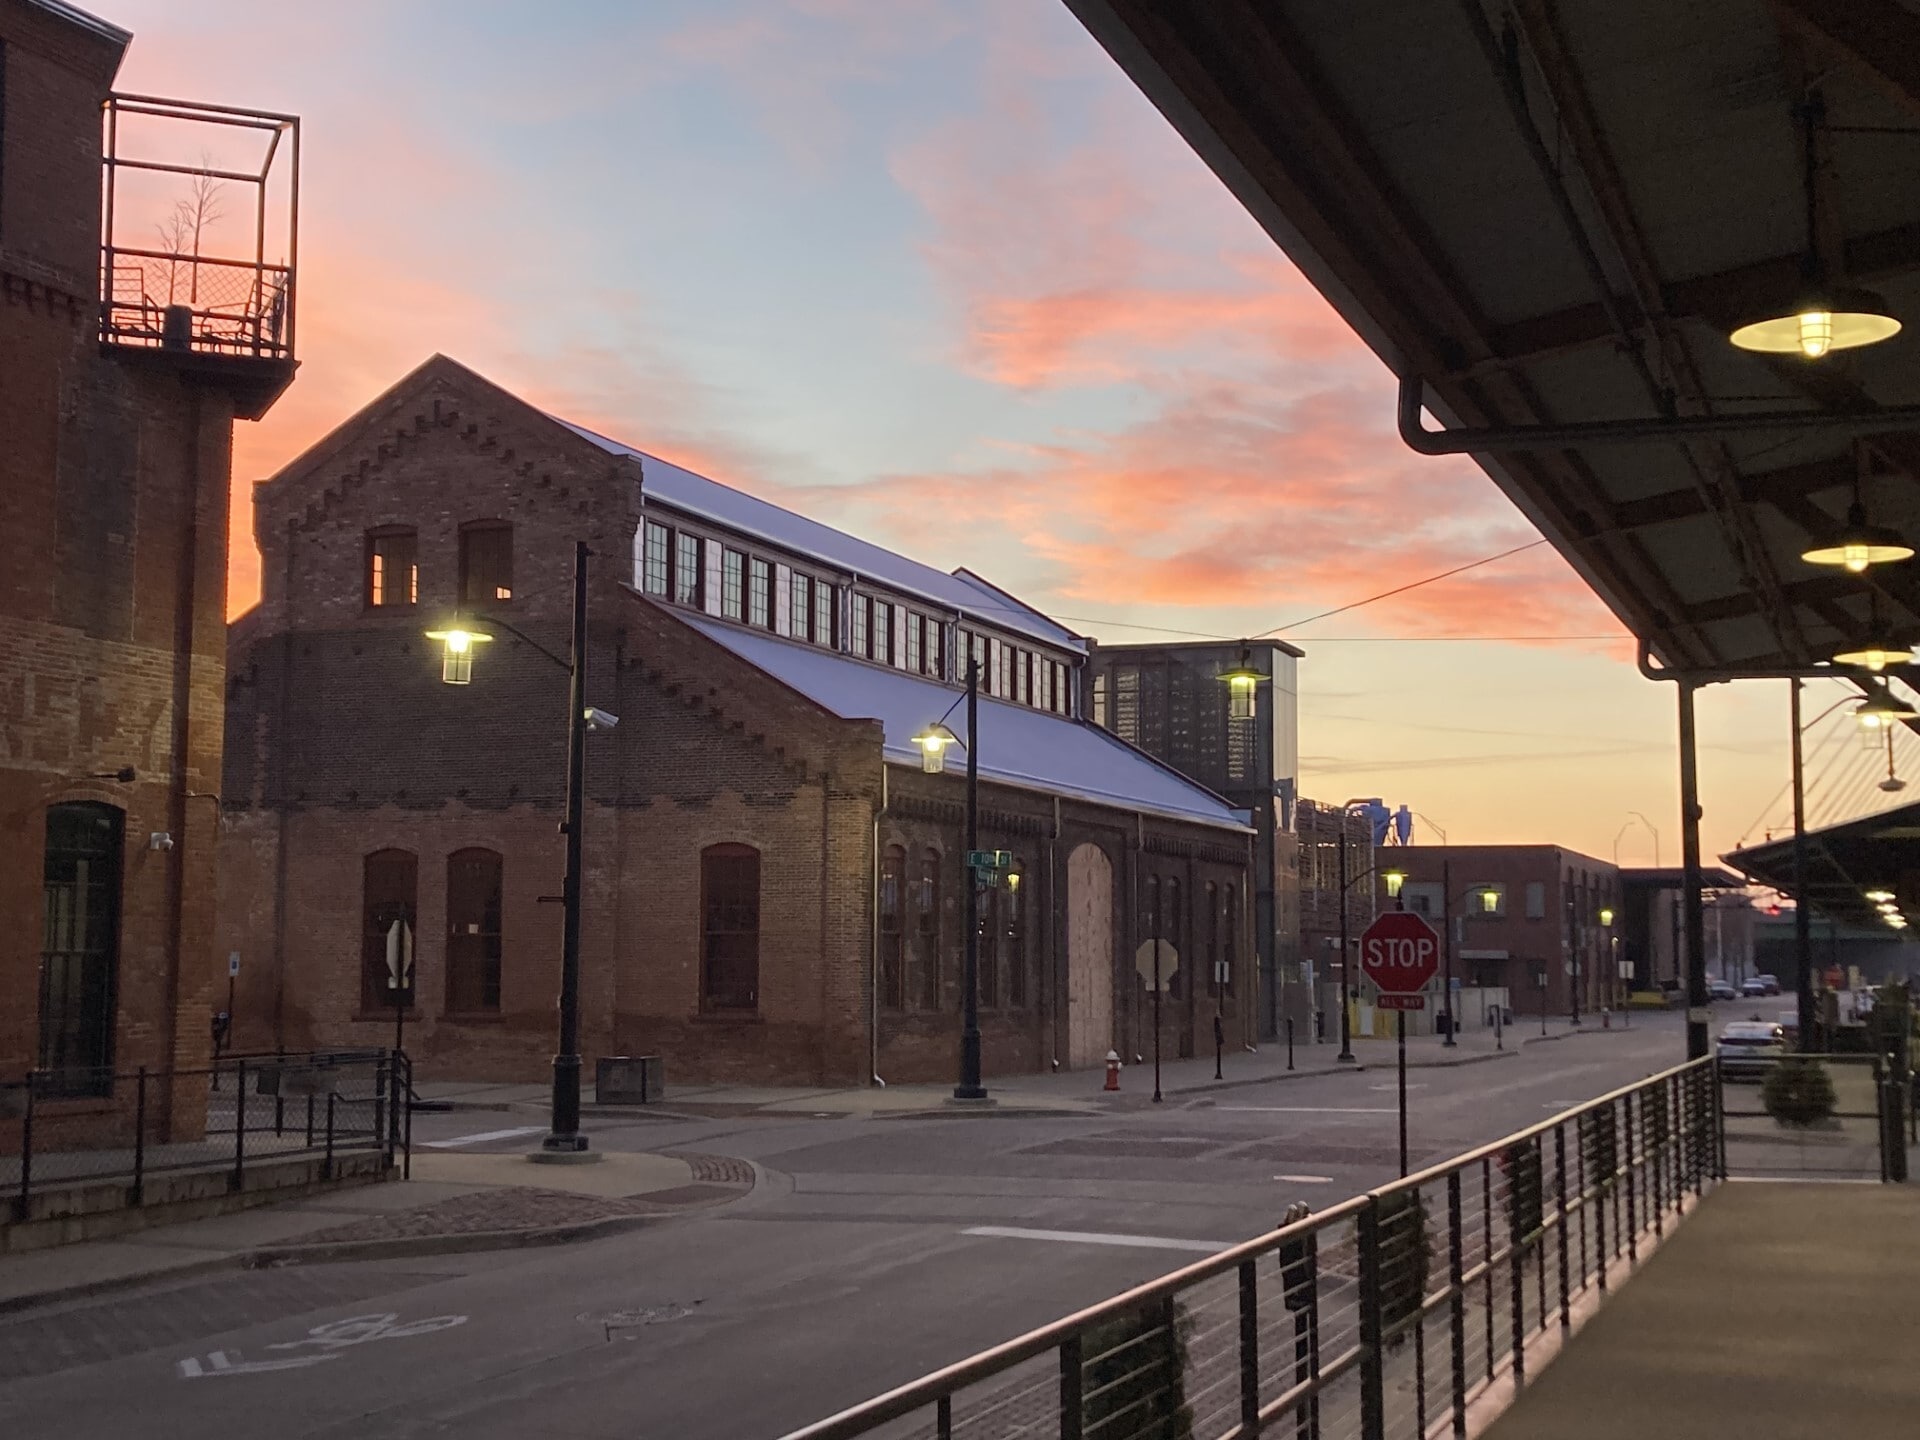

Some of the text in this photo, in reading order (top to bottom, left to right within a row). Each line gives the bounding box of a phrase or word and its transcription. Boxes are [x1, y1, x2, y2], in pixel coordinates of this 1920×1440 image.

[1367, 938, 1434, 967] STOP
[1381, 996, 1421, 1007] ALL WAY
